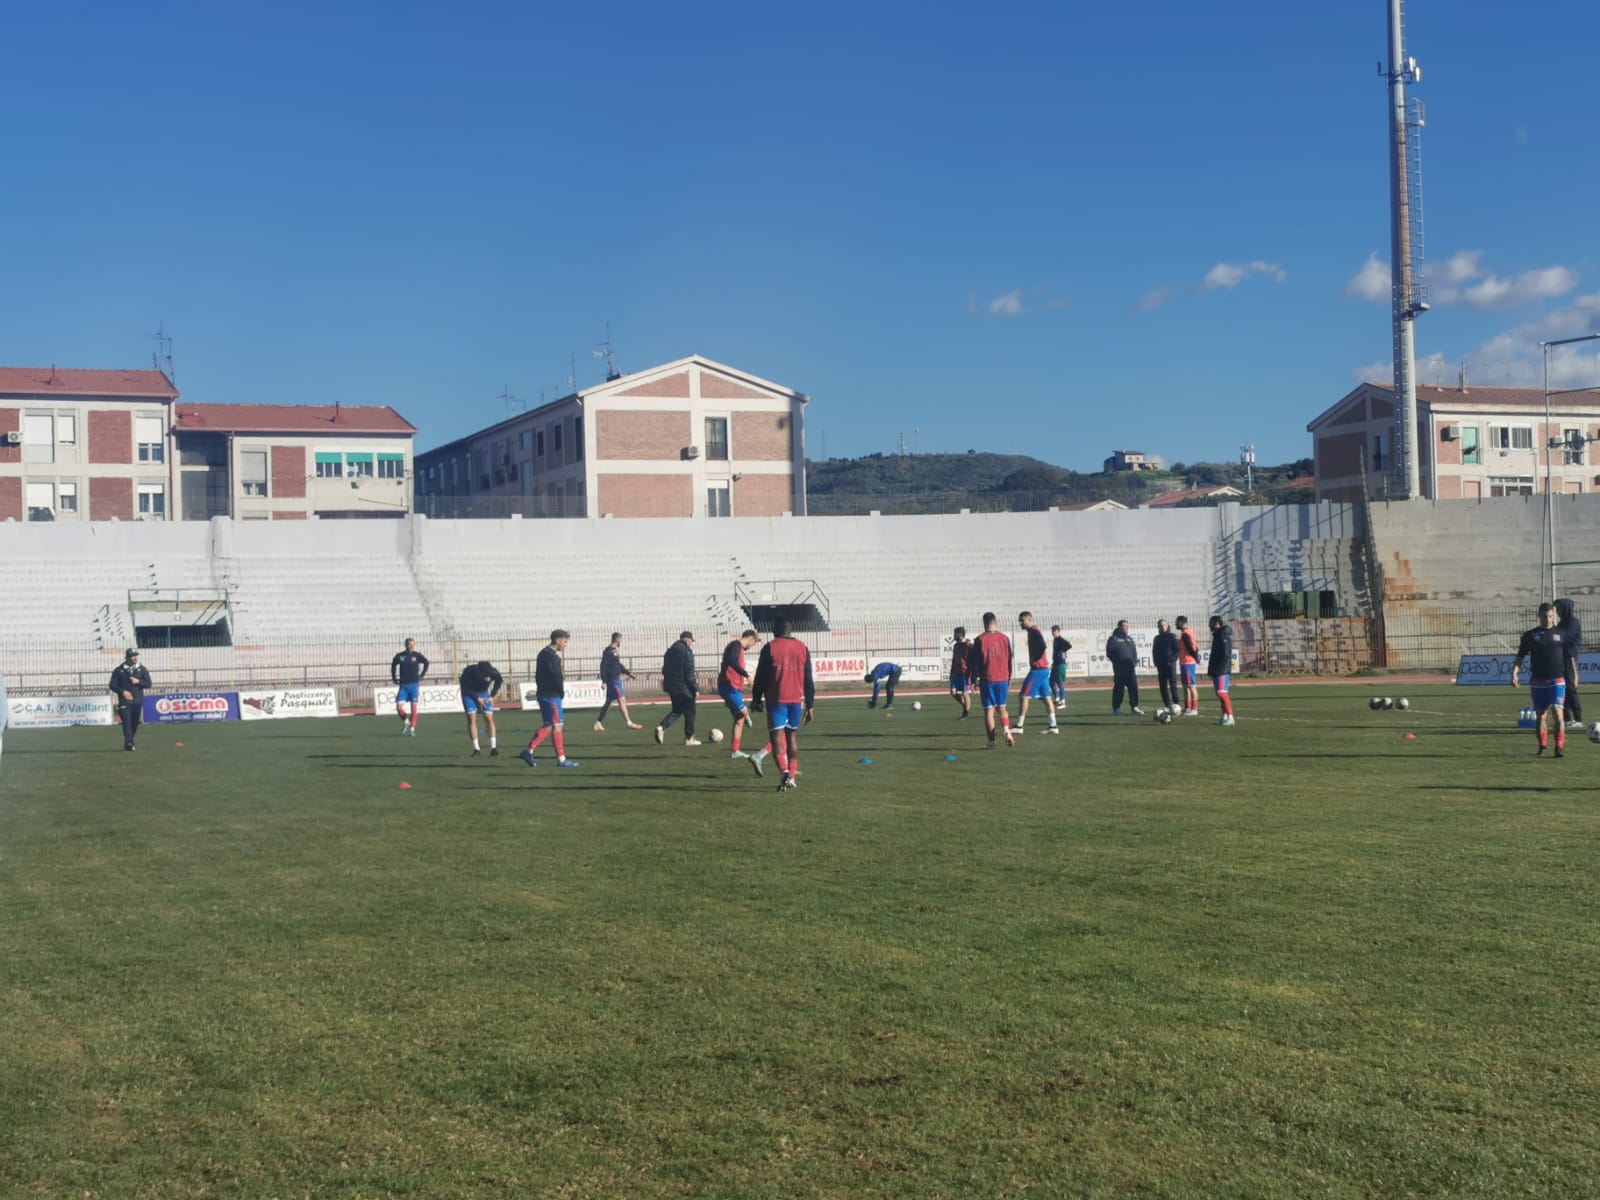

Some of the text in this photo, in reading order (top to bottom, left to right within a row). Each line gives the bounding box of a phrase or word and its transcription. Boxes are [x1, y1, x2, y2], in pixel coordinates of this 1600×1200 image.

[815, 661, 834, 673] SAN
[836, 659, 865, 672] PAOLO
[902, 662, 940, 672] chem
[280, 698, 335, 709] Pasquale
[422, 689, 456, 707] pass
[67, 702, 110, 713] Vaillant
